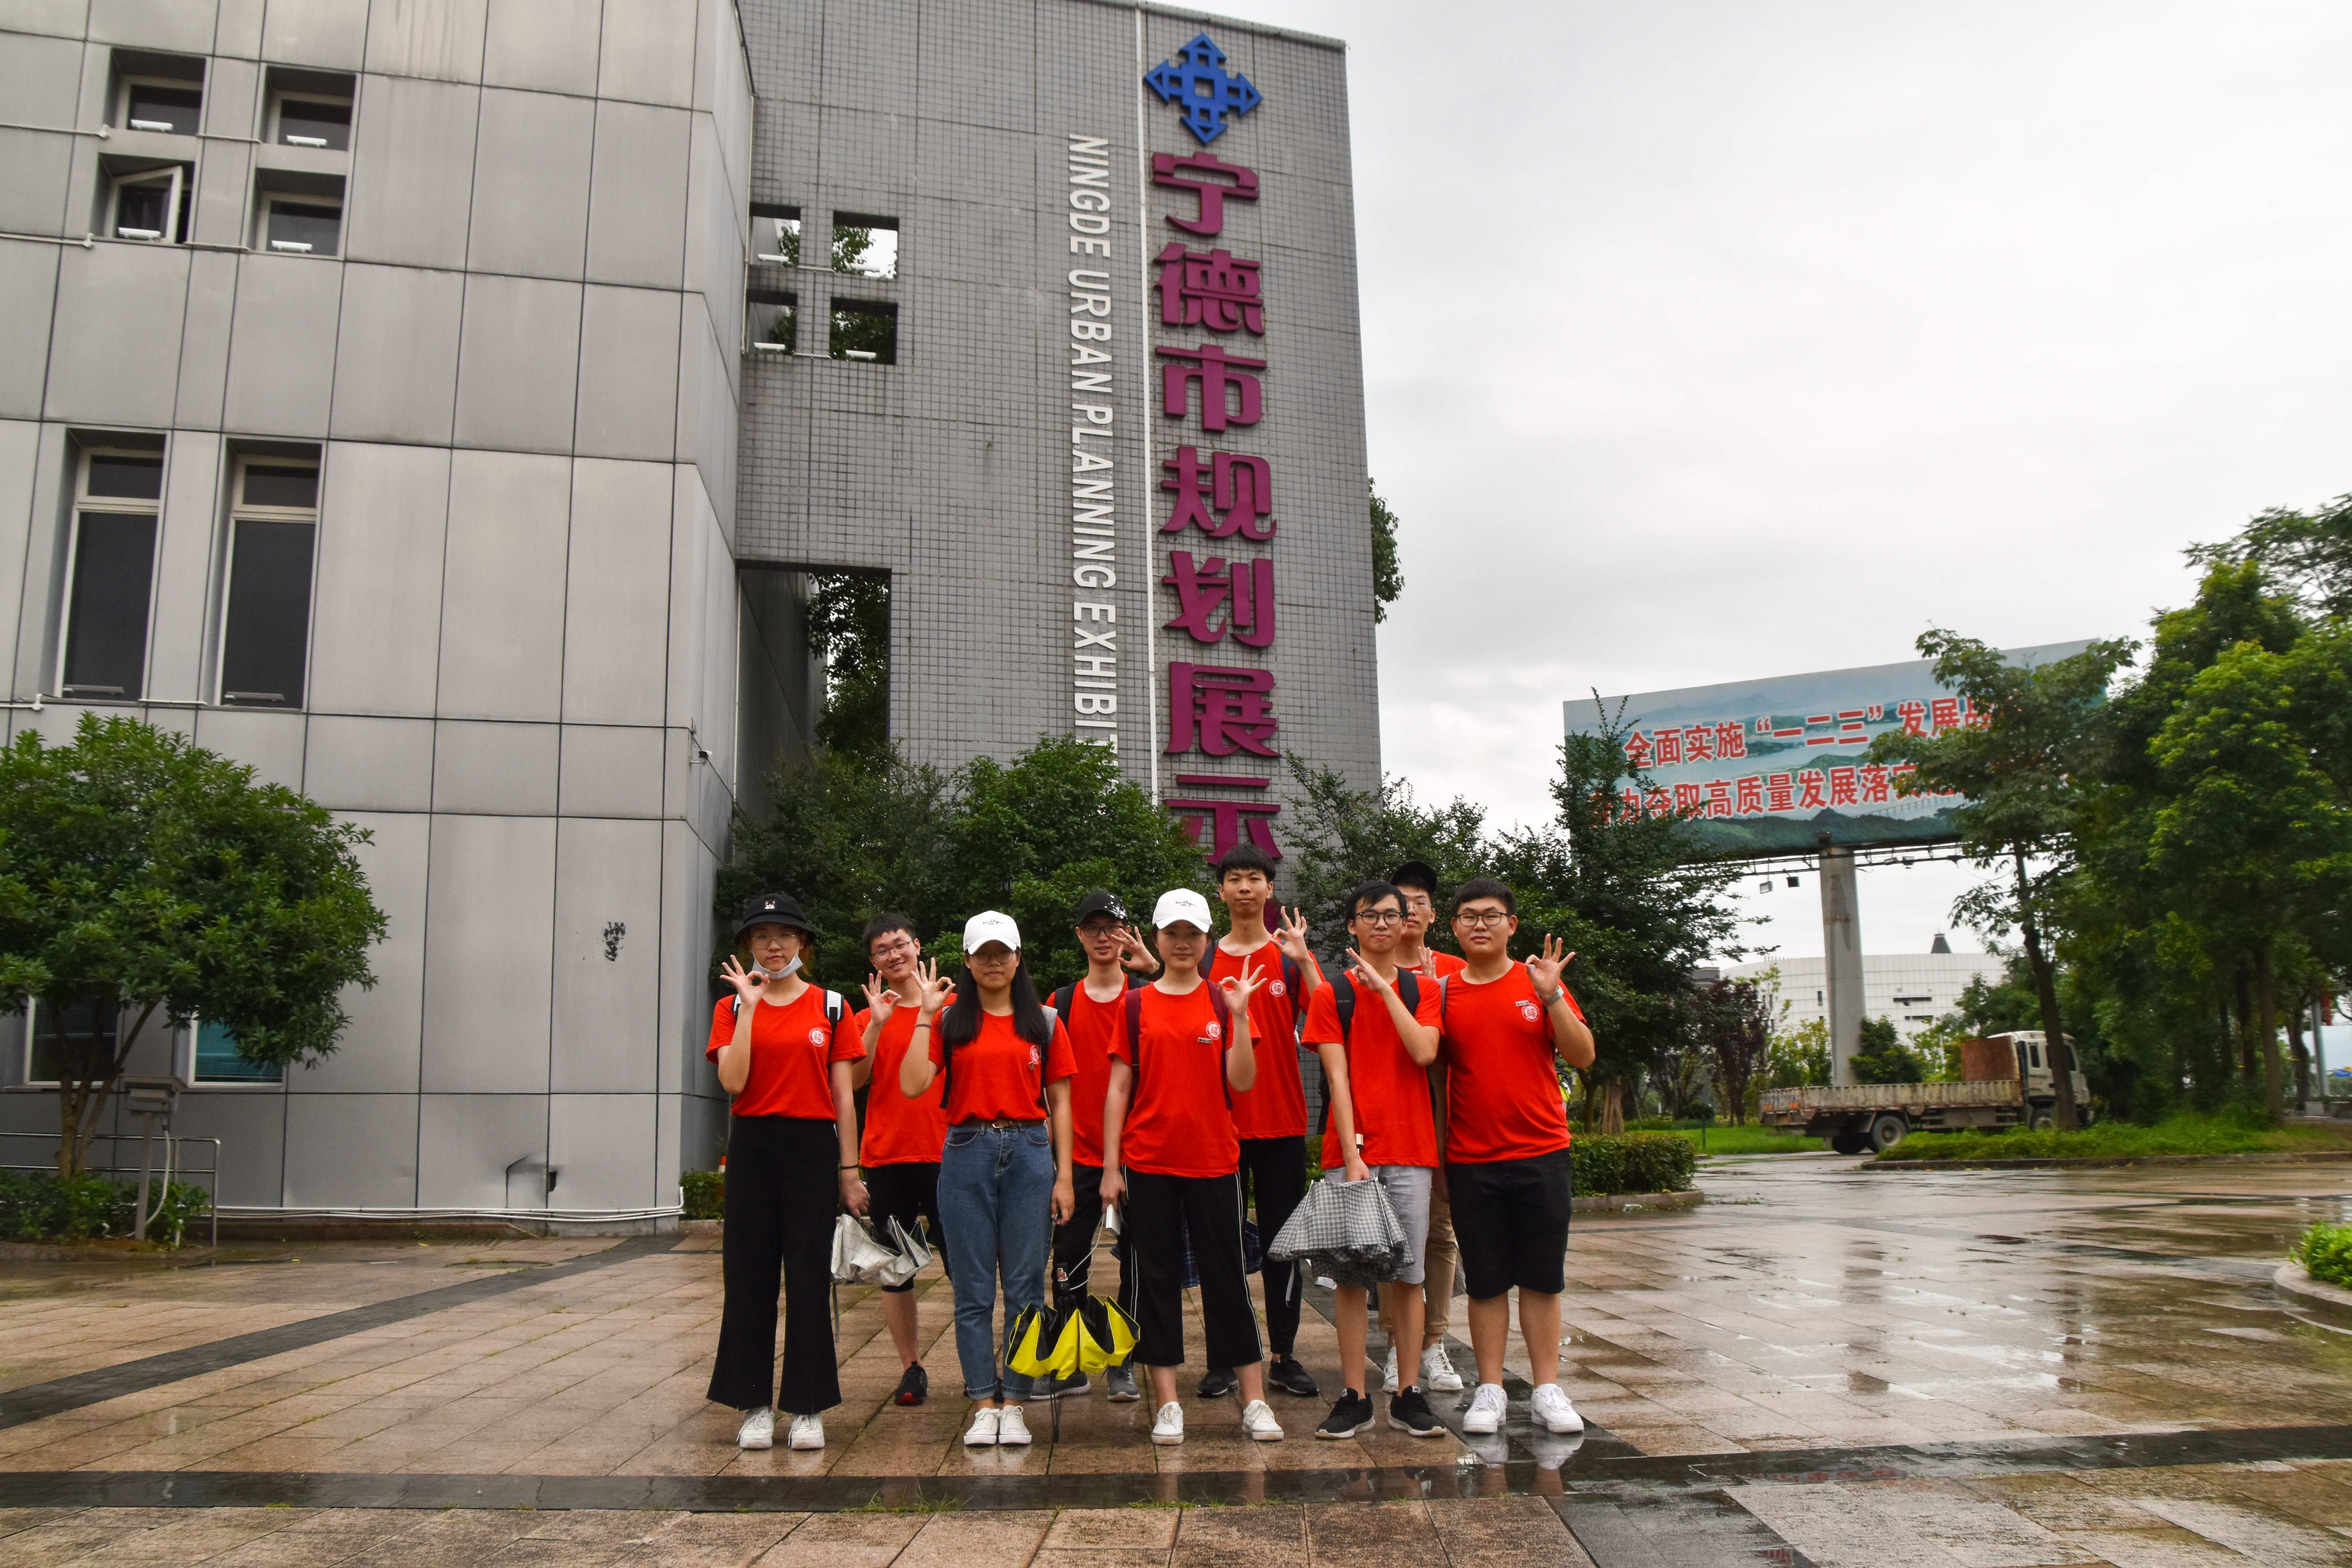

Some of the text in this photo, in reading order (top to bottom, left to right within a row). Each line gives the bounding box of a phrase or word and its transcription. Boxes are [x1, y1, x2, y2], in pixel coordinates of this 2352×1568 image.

[1069, 133, 1119, 817] NINGDE URBAN PLANNING EXHIBIT
[1152, 152, 1283, 934] 宁德市规划展示
